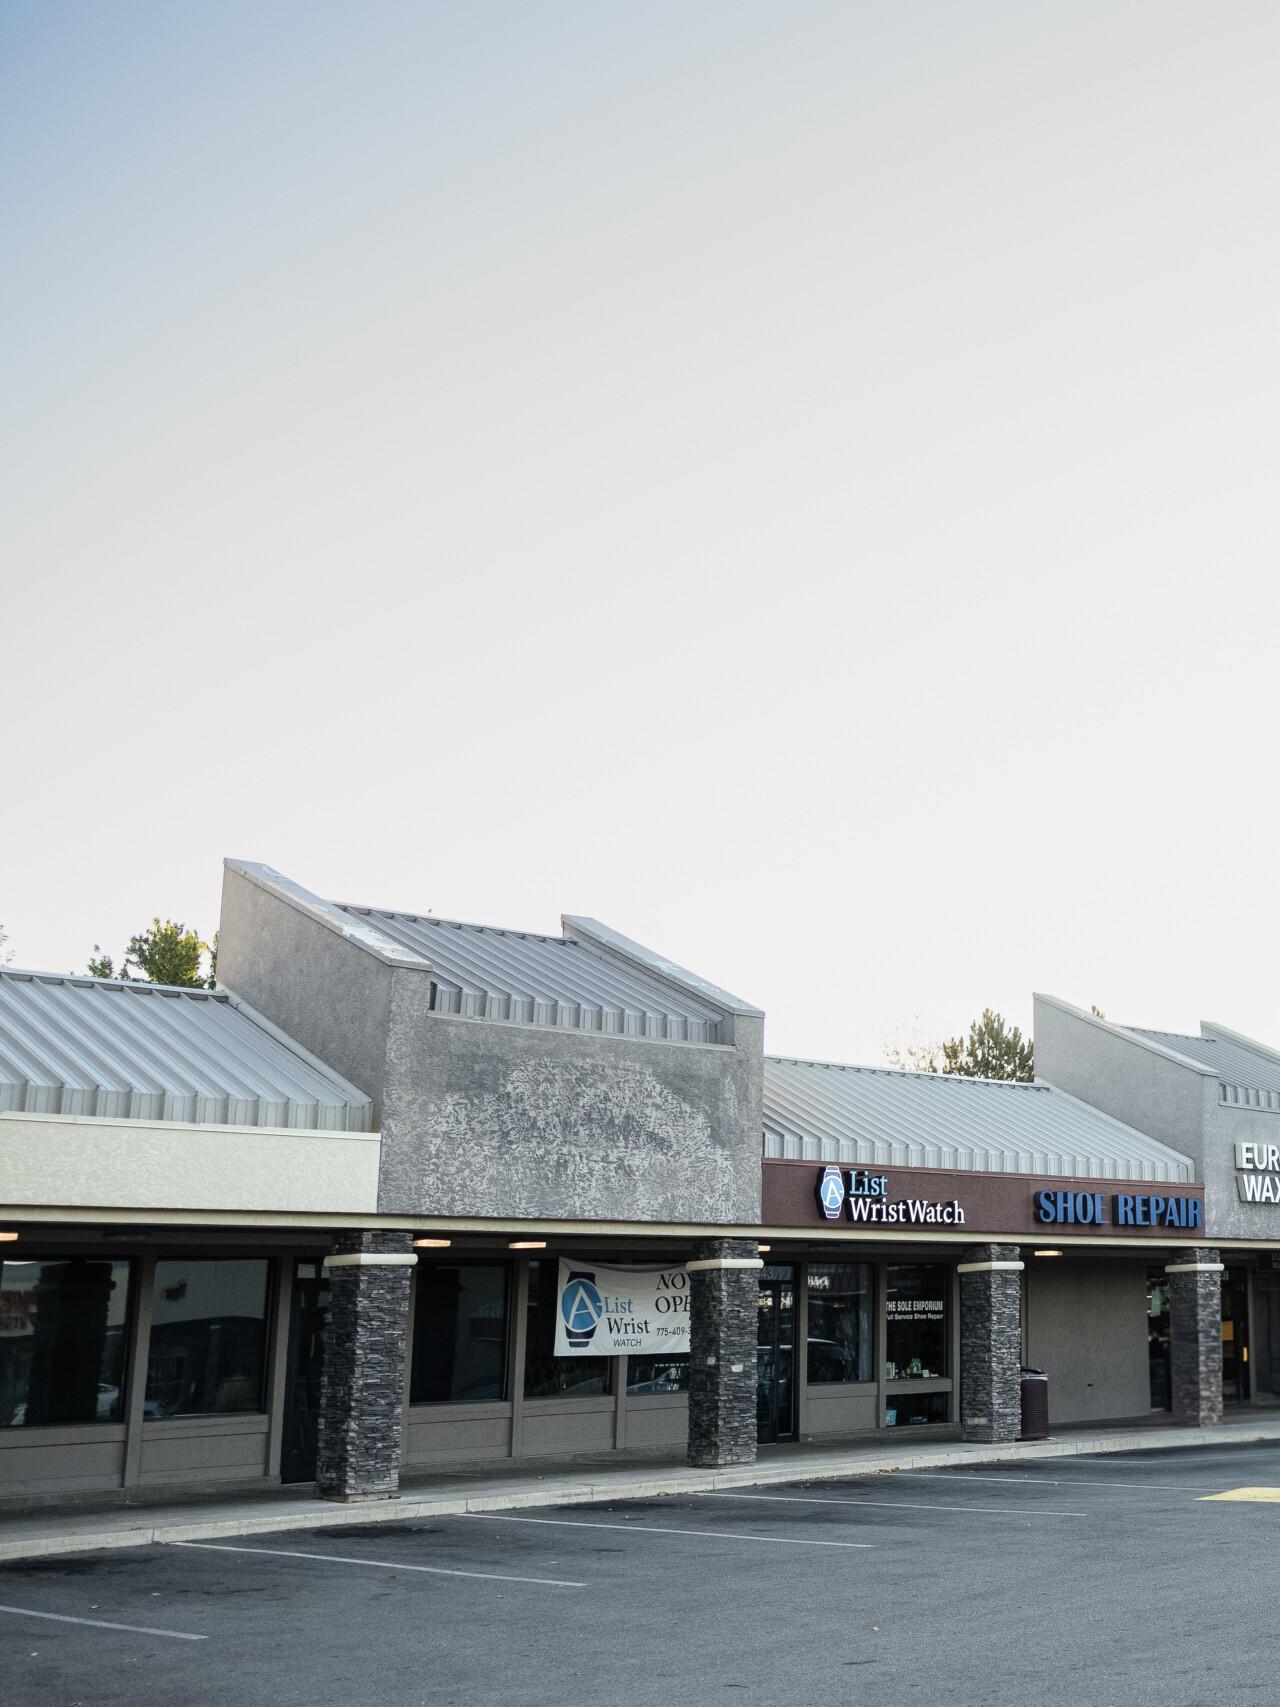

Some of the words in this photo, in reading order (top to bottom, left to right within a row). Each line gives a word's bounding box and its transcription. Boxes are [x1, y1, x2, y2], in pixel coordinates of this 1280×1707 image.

[849, 1170, 888, 1196] List
[1036, 1190, 1111, 1224] SHOE
[1114, 1194, 1203, 1229] REPAIR
[603, 1296, 633, 1313] List
[655, 1295, 691, 1313] OPE
[886, 1301, 896, 1311] THE
[897, 1301, 912, 1311] SOLE
[913, 1300, 943, 1311] EMPORIUM
[606, 1317, 650, 1335] Wrist
[613, 1338, 642, 1348] WATCH
